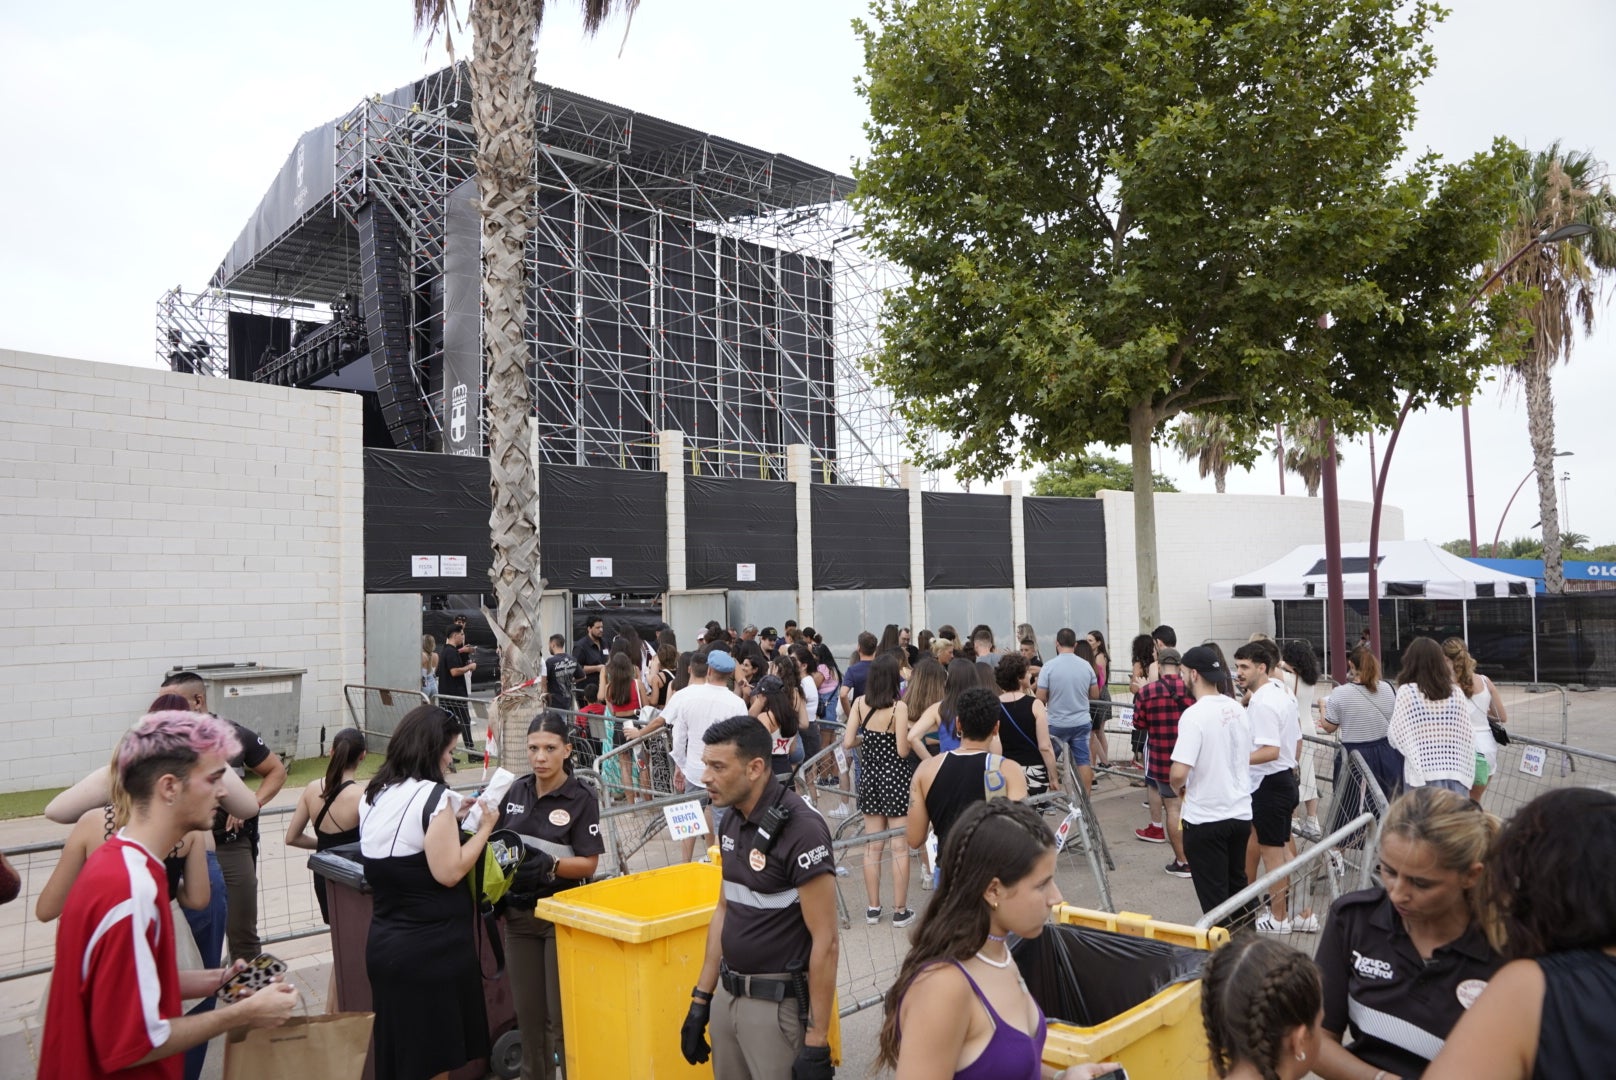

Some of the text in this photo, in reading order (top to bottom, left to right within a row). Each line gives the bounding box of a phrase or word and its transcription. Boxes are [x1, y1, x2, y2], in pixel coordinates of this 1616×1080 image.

[672, 812, 697, 824] RENTA
[674, 822, 700, 834] TODO
[809, 845, 825, 857] grupo
[1361, 957, 1390, 970] grupo
[1359, 965, 1393, 979] control
